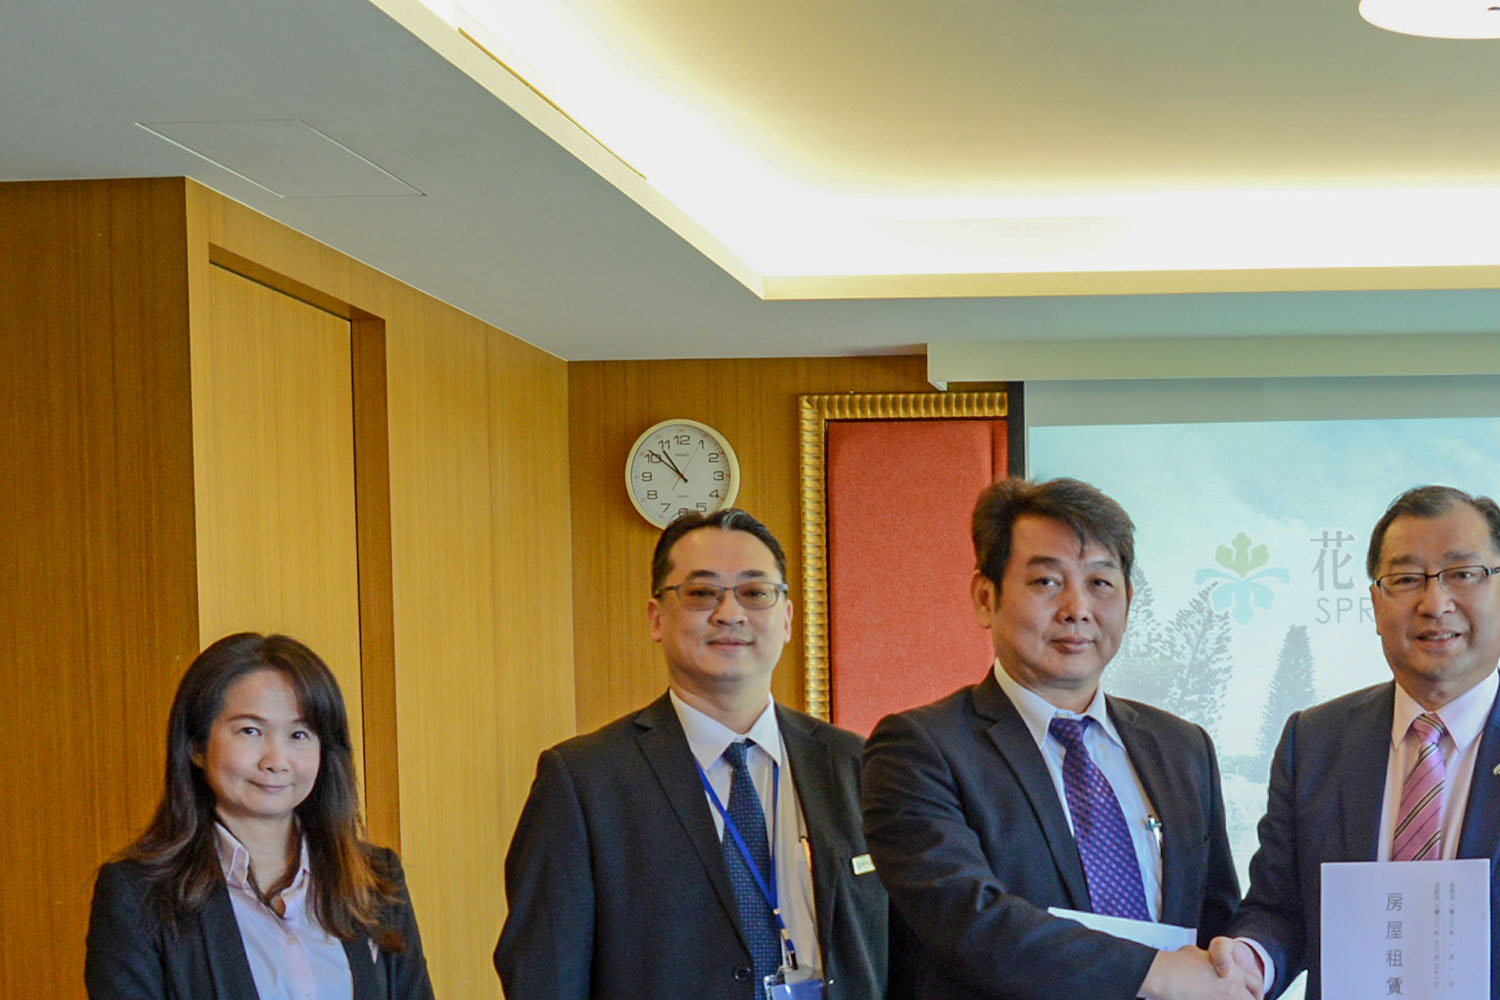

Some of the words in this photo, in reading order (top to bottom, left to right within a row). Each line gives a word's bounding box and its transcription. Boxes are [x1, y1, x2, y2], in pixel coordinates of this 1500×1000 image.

[658, 440, 671, 450] 11
[673, 435, 691, 445] 12
[644, 453, 661, 464] 10
[708, 452, 719, 463] 2
[641, 472, 652, 481] 9
[713, 471, 724, 481] 3
[647, 490, 658, 500] 8
[709, 489, 719, 499] 4
[660, 503, 671, 513] 7
[696, 502, 707, 513] 5
